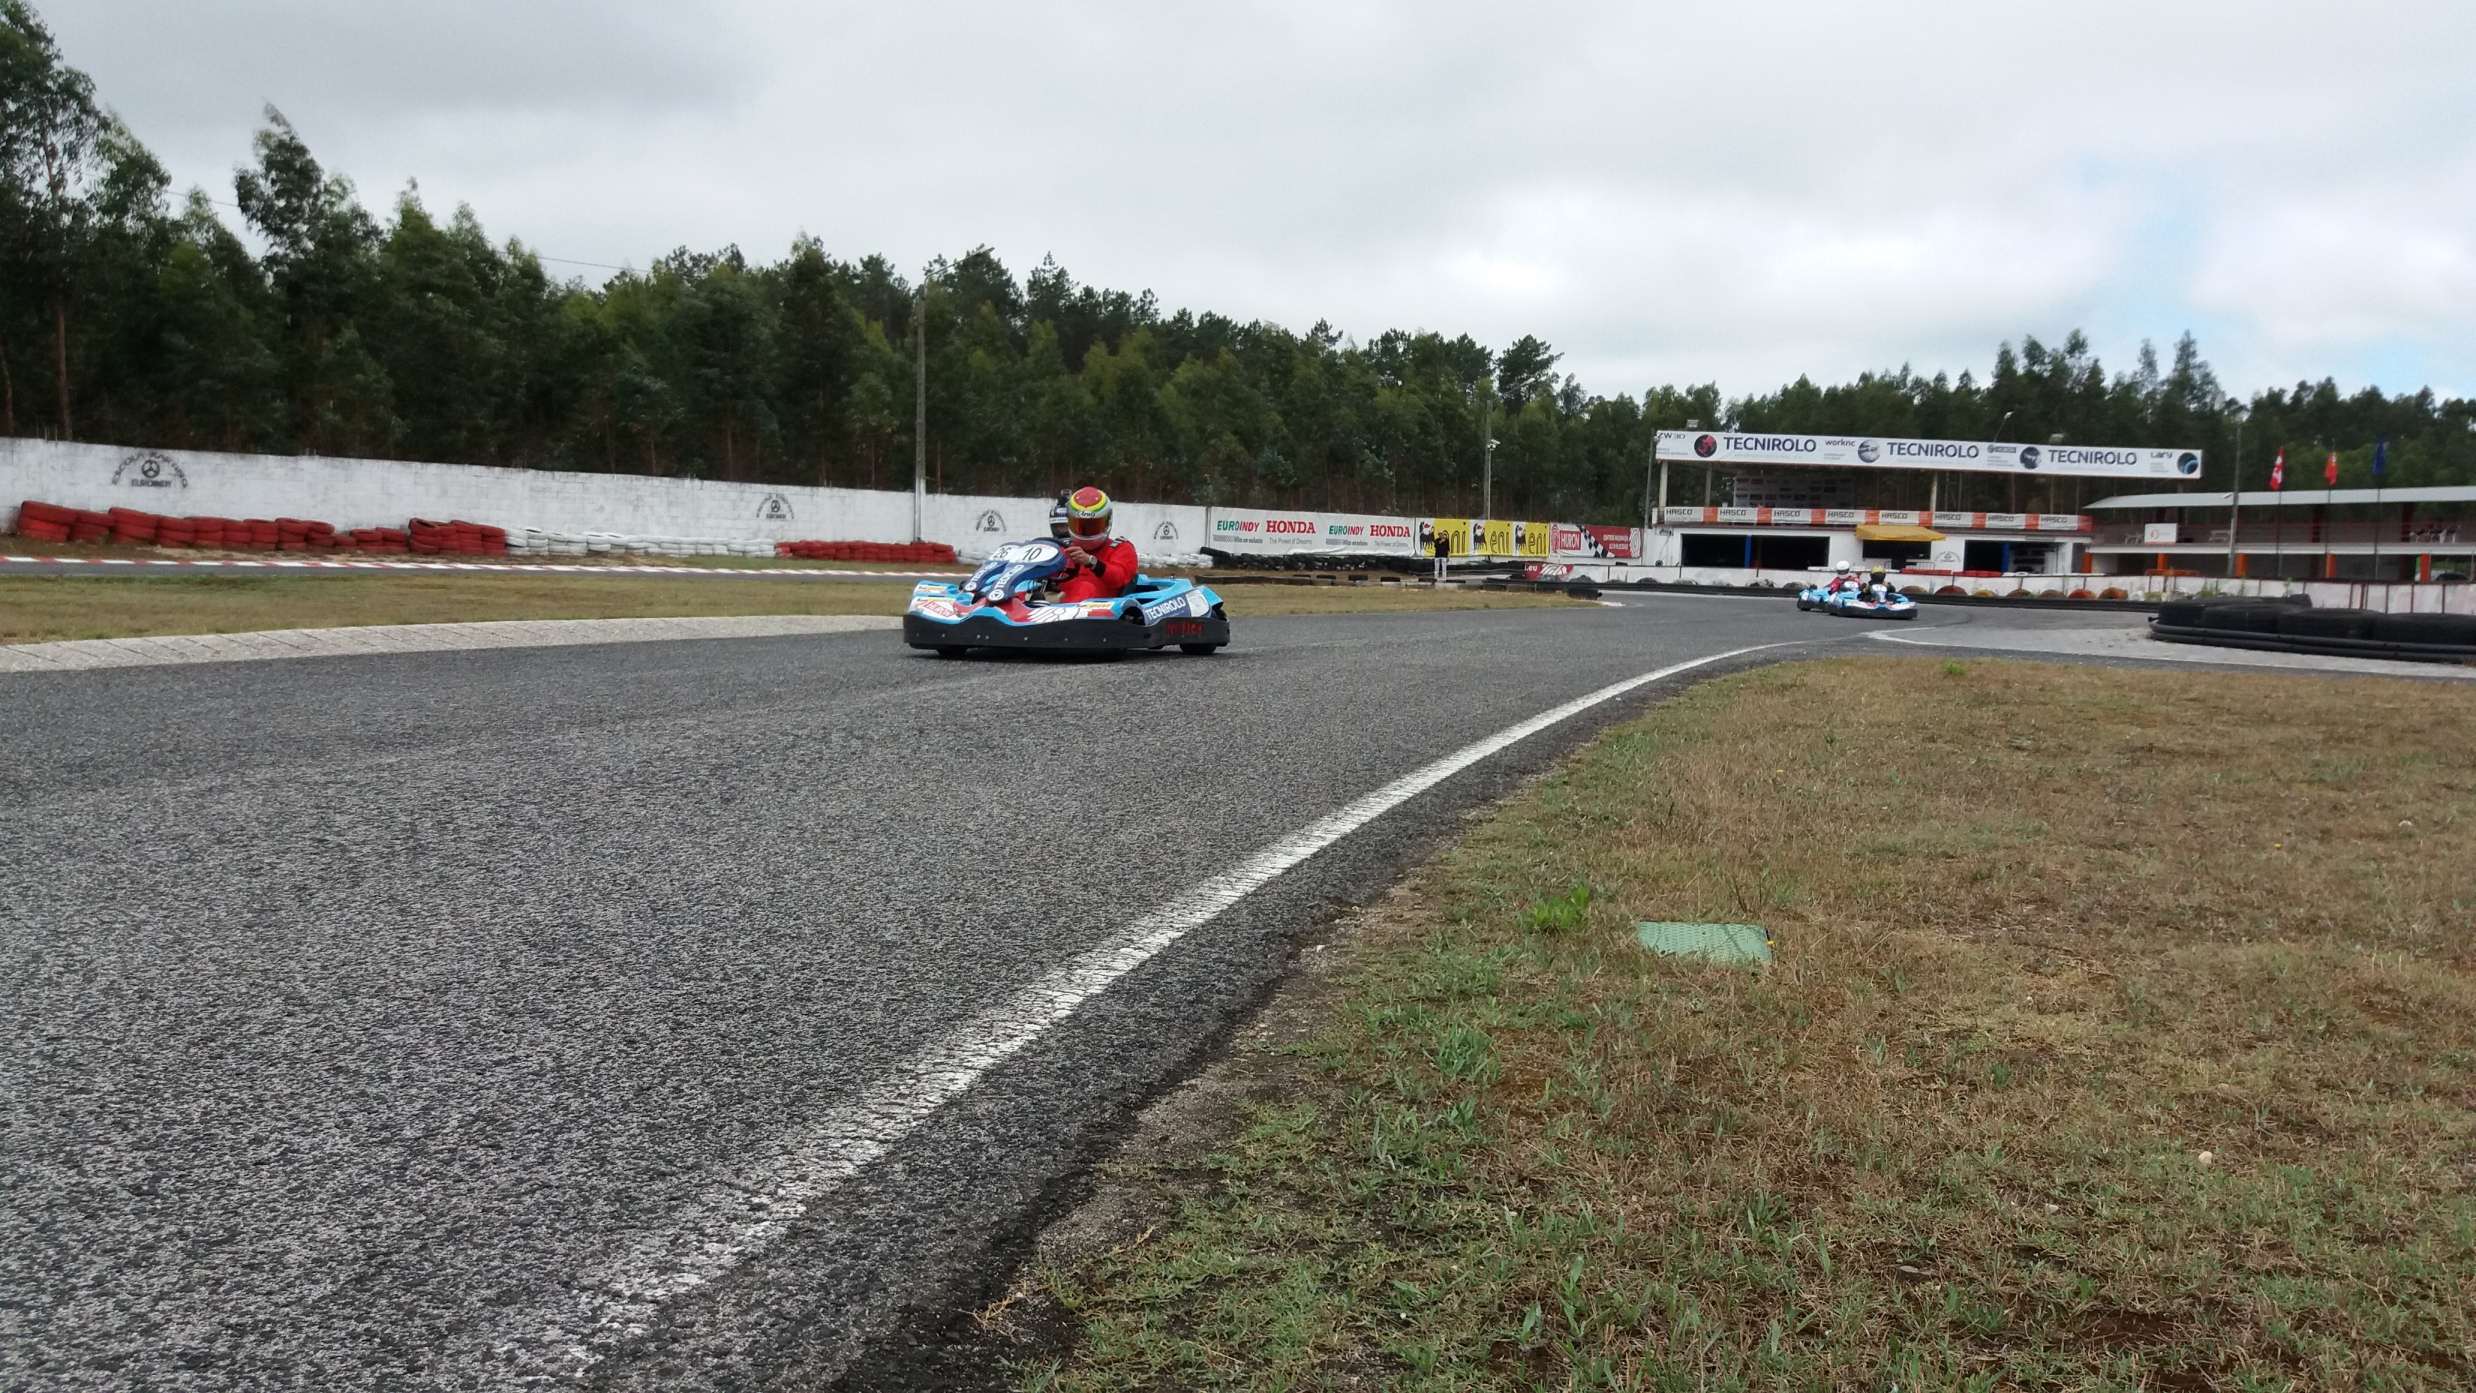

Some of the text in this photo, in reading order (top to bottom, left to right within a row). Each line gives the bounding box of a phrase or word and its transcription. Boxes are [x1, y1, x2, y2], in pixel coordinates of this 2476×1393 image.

[1724, 436, 1817, 452] TECNIROLO
[1887, 442, 1979, 458] TECNIROLO
[2048, 449, 2137, 465] TECNIROLO
[1773, 510, 1800, 518] HASCO
[1827, 511, 1855, 519] HASCO
[1934, 513, 1961, 521] HASCO
[1217, 520, 1316, 534] EUROINDY HONDA
[1329, 525, 1410, 537] EUROINDY HONDA
[1490, 522, 1511, 553] eni
[1528, 525, 1548, 554] eni
[1561, 533, 1580, 549] HURON
[1023, 547, 1042, 560] 10
[1145, 596, 1186, 620] TECNIROLO
